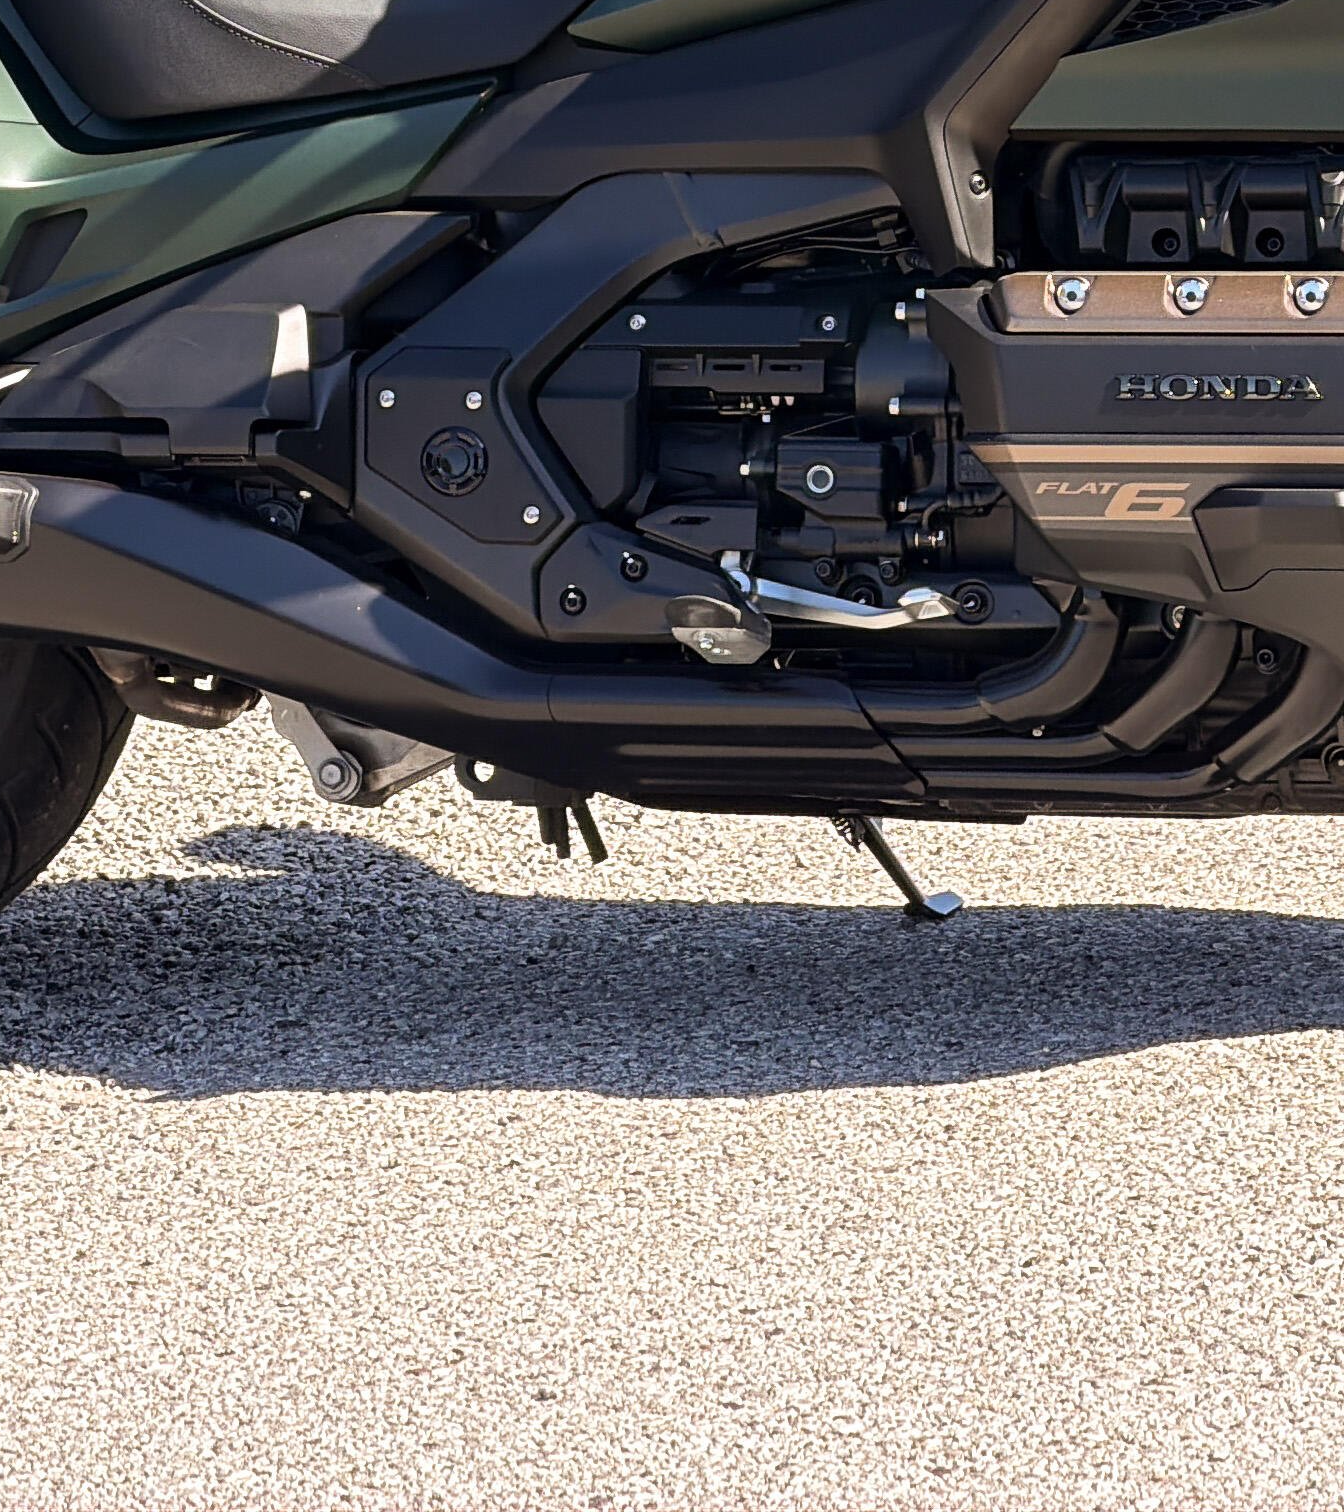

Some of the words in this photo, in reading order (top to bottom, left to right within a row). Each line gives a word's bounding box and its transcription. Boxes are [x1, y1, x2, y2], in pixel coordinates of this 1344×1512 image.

[1114, 373, 1324, 401] HONDA
[1035, 482, 1119, 495] FLAT
[1105, 483, 1191, 519] 6
